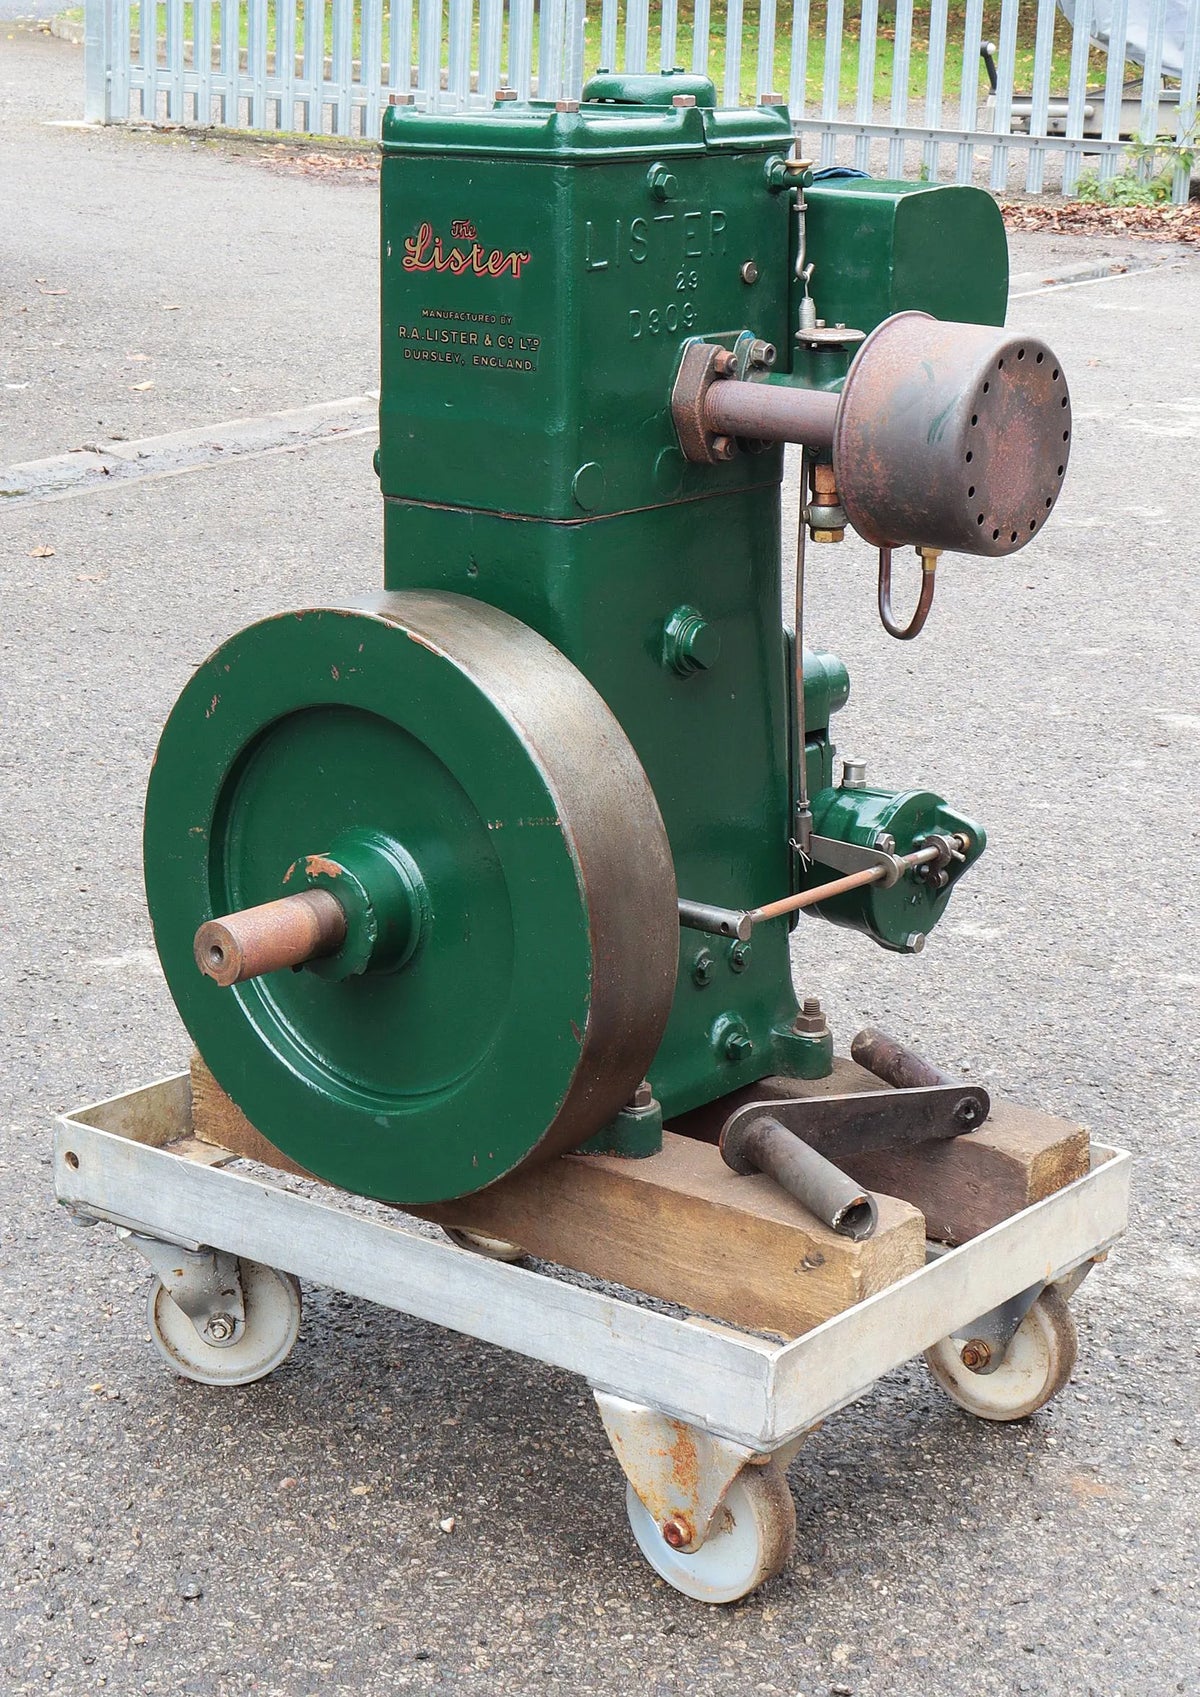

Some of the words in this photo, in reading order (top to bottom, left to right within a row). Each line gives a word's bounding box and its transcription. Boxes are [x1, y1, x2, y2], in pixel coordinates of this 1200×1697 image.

[451, 219, 478, 240] The
[586, 209, 727, 271] LISTER
[402, 222, 531, 278] Lister
[422, 309, 496, 323] MANUFACTURED
[500, 316, 512, 325] BY
[484, 335, 492, 347] &
[404, 349, 465, 364] DURSLEY,
[473, 356, 536, 372] ENGLAND.
